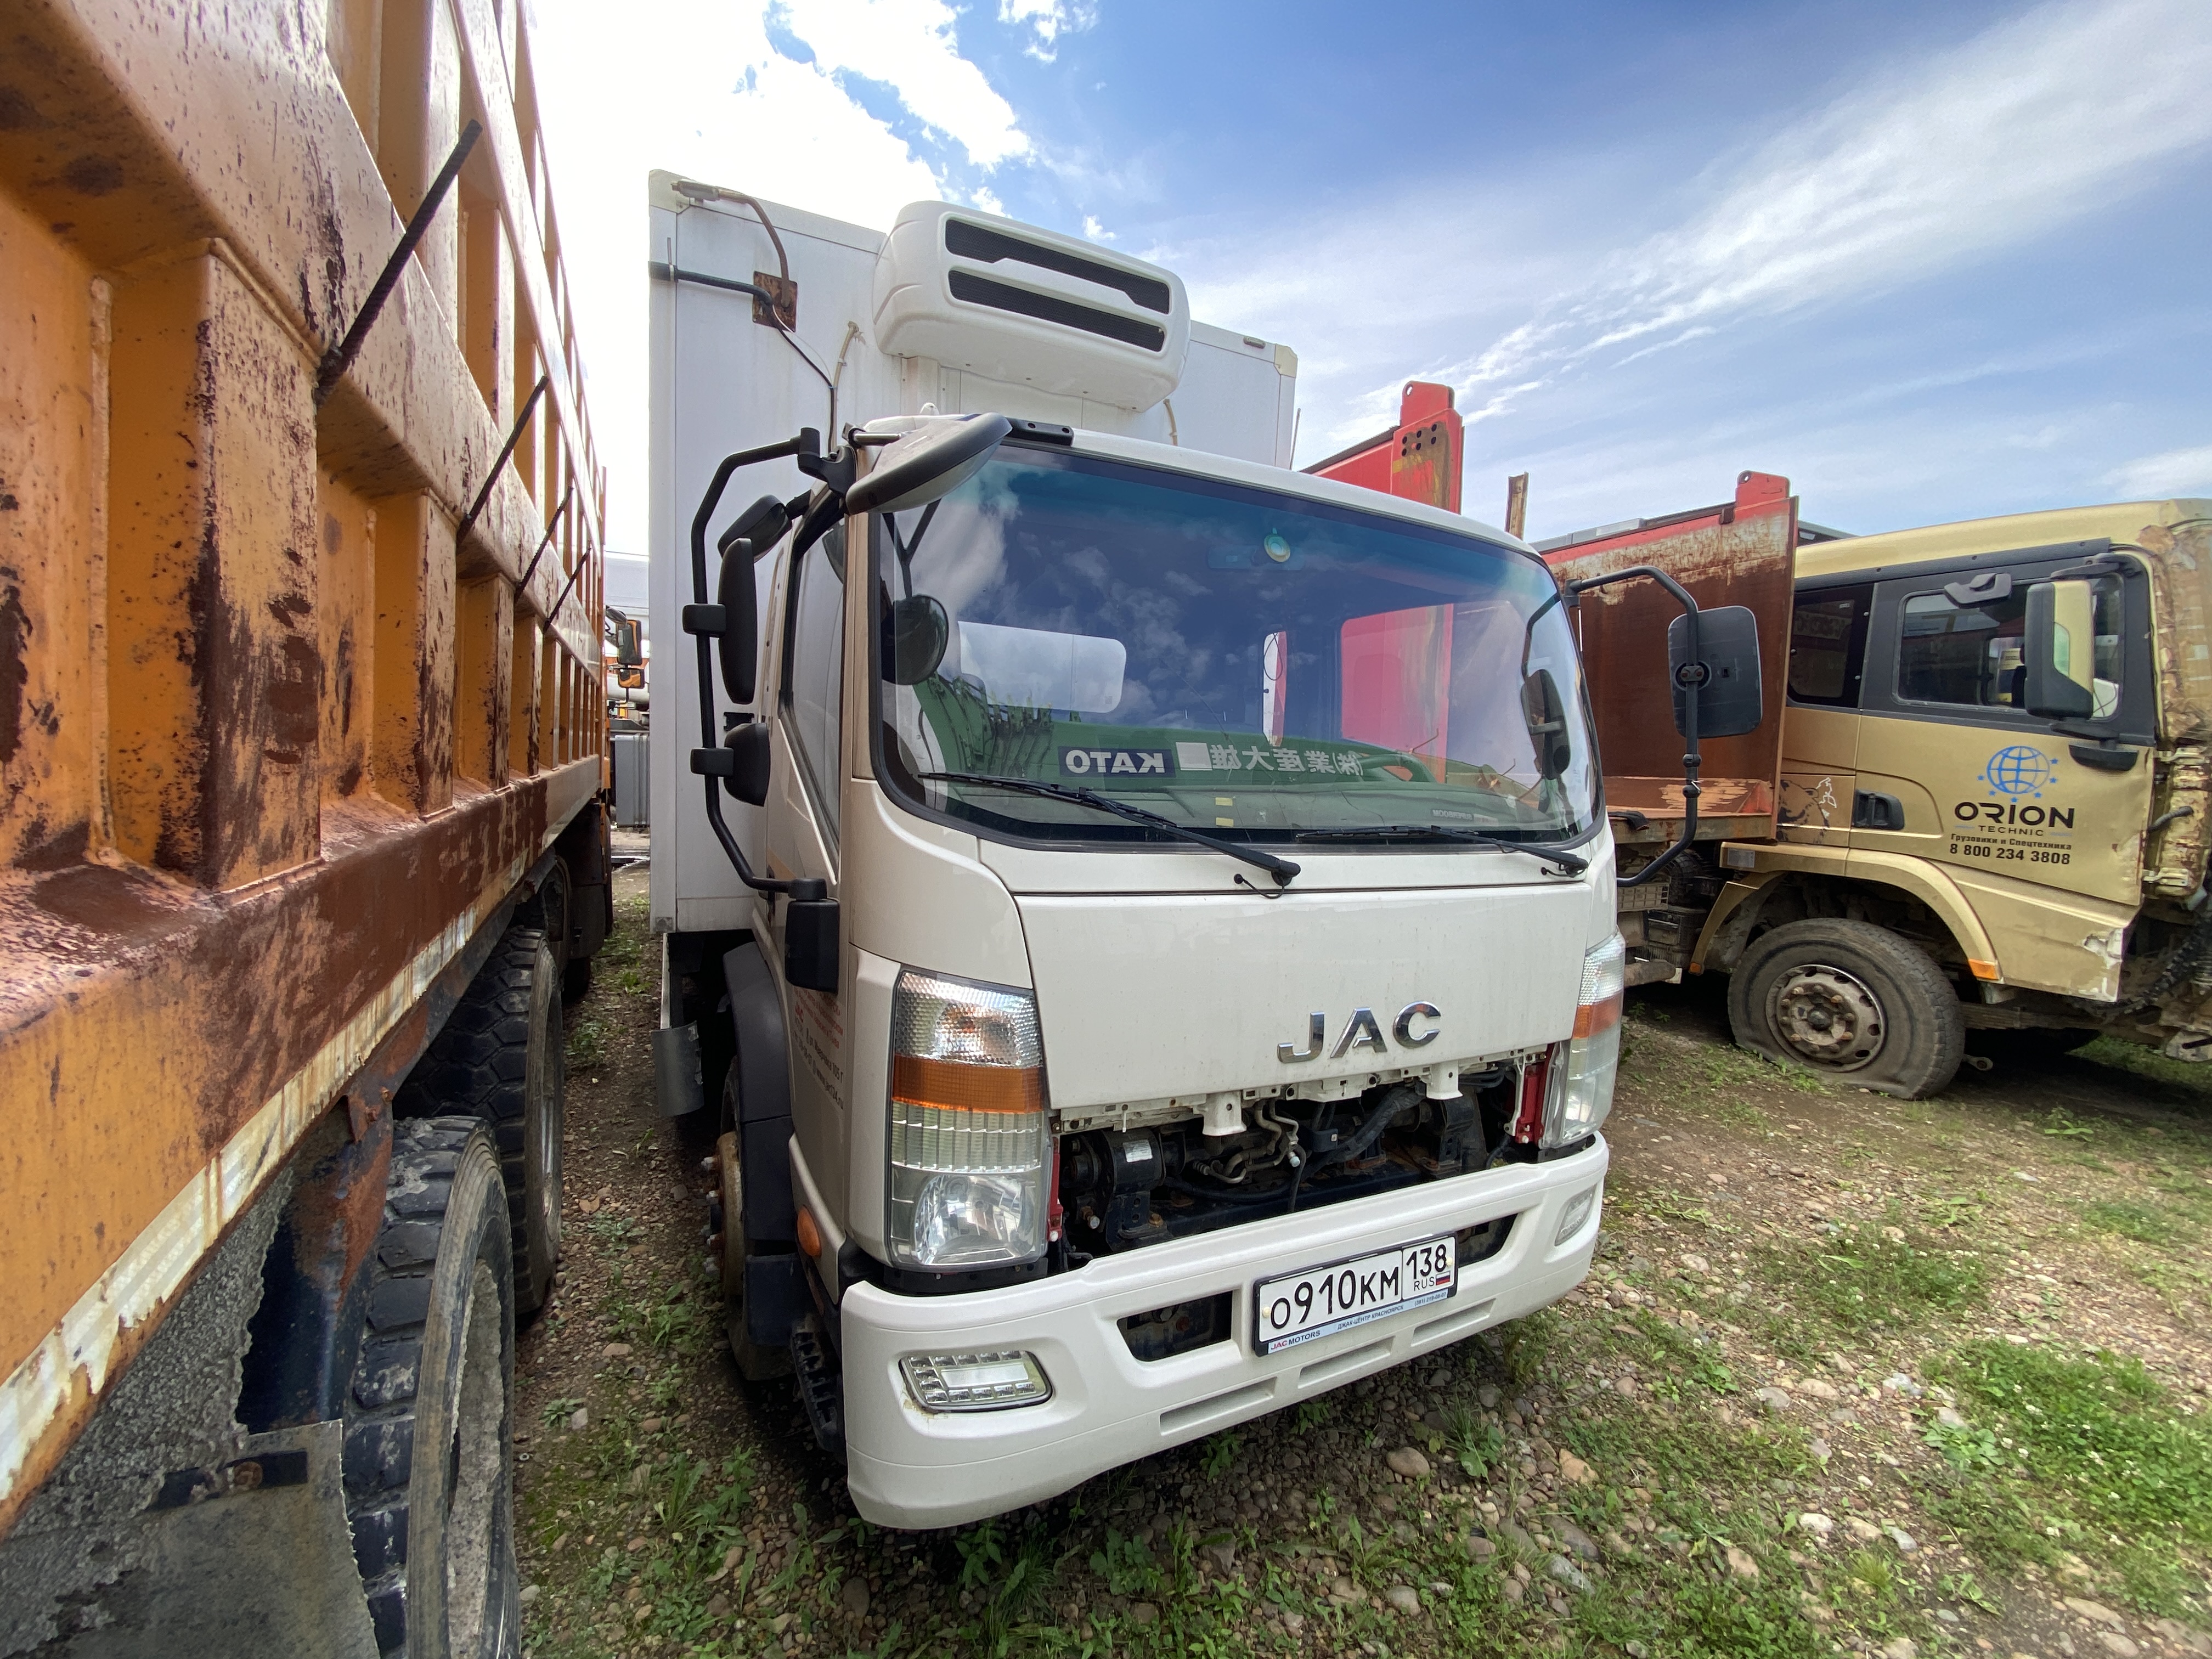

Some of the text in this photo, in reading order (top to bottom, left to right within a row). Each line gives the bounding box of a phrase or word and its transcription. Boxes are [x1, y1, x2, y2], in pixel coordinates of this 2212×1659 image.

[1955, 802, 2074, 828] ORION
[1978, 825, 2044, 836] TECHNIC
[1951, 833, 1997, 844] Грузовики
[2010, 838, 2072, 850] Спецтехника
[1950, 843, 2070, 864] 8 800 234 3808
[1277, 1001, 1441, 1063] JAC
[1406, 1244, 1447, 1279] 138
[1414, 1277, 1435, 1291] RUS
[1372, 1305, 1404, 1319] КРАСНОЯРСК
